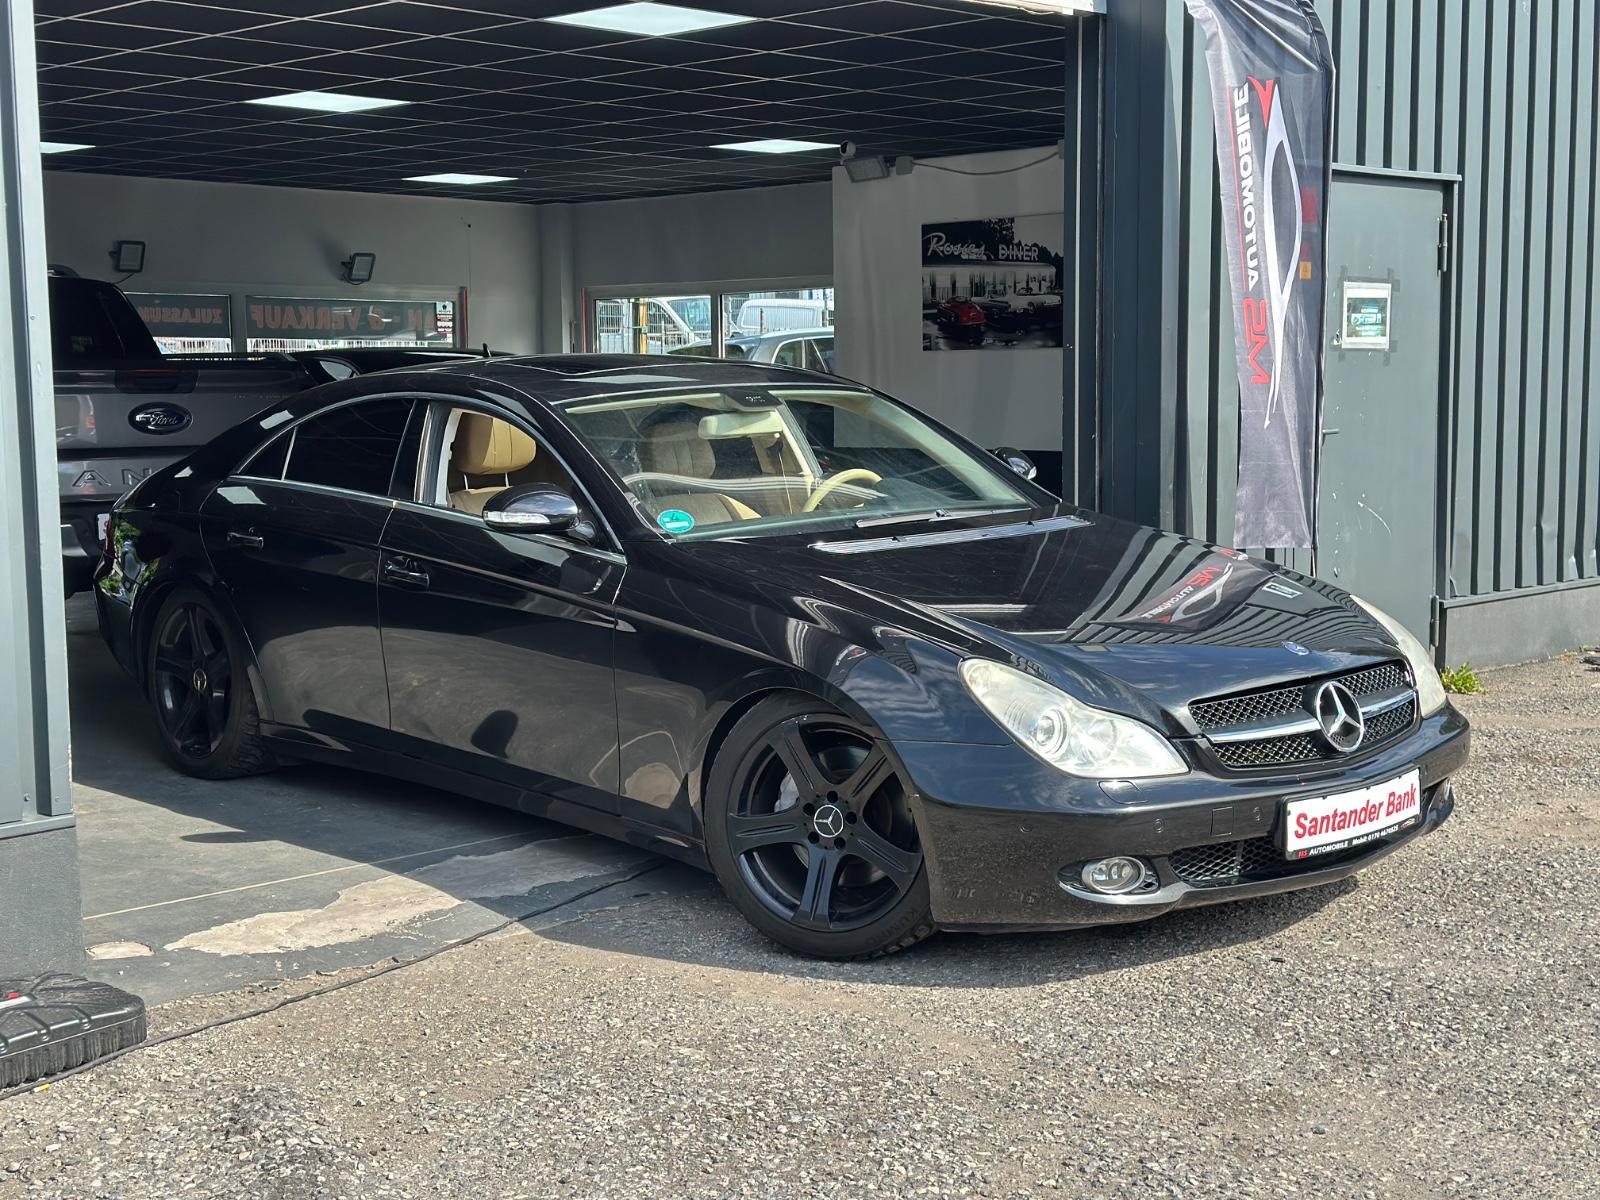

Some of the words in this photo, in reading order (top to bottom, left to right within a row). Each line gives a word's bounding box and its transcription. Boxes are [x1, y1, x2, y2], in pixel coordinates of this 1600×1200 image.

[998, 243, 1039, 260] DINER
[150, 411, 179, 425] Ford
[1294, 799, 1385, 839] Santander
[1385, 783, 1417, 818] Bank
[1309, 841, 1348, 856] AUTOMOBILE
